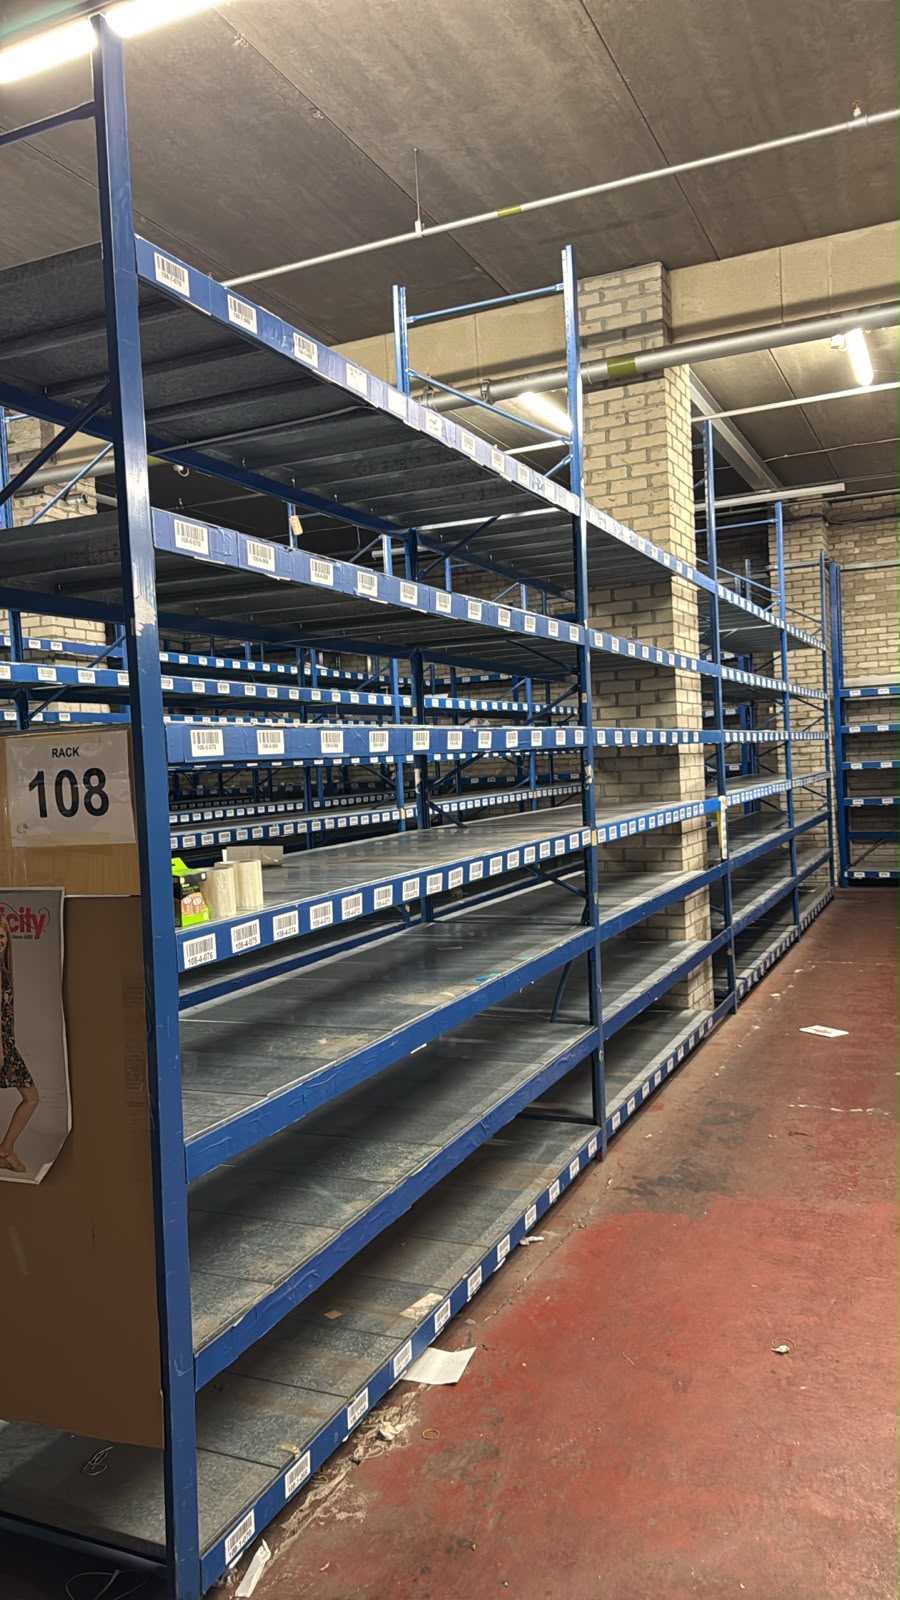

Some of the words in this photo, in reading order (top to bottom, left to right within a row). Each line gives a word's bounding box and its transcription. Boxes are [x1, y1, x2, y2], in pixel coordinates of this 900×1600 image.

[51, 746, 80, 759] RACK
[28, 767, 110, 819] 108
[235, 936, 258, 950] 108-4-075
[188, 951, 214, 967] 108-4-076
